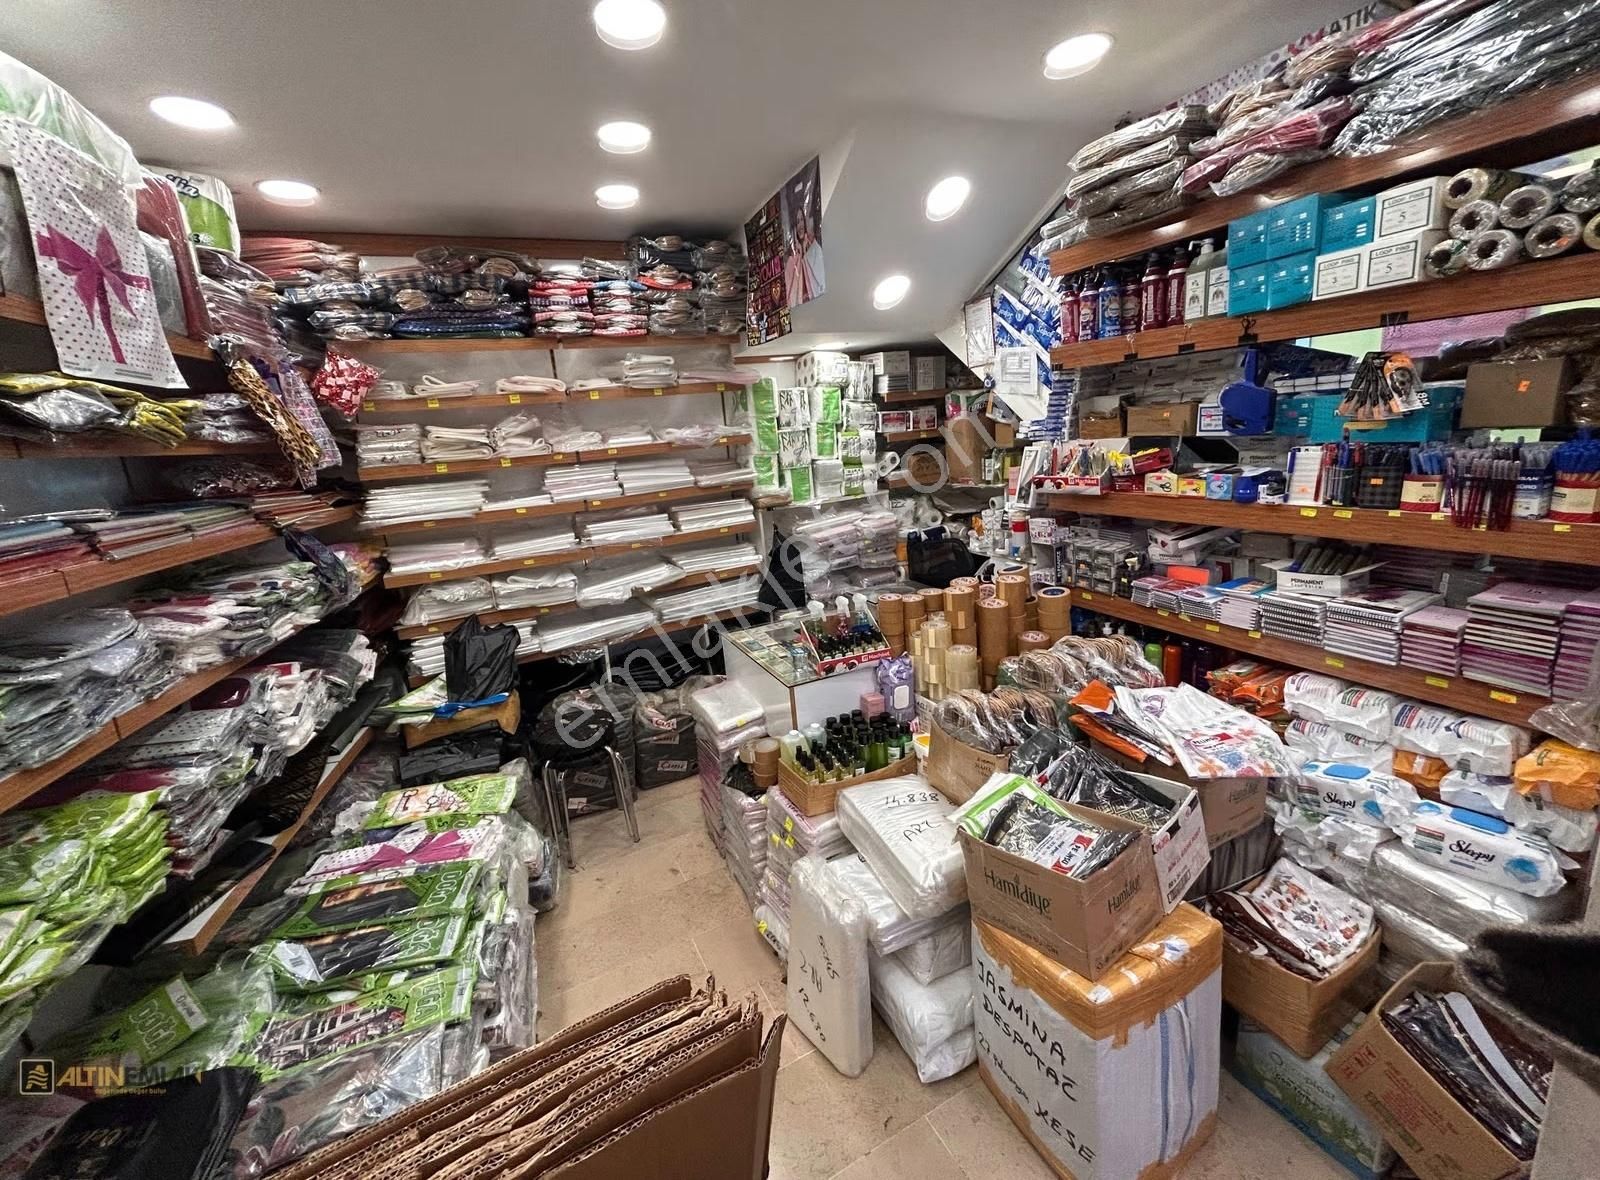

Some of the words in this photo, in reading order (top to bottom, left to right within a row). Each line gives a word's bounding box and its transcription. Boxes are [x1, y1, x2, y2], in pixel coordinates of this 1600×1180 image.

[1375, 247, 1394, 258] LOOP
[1384, 262, 1393, 274] 5
[1290, 577, 1324, 586] PERMANENT
[1322, 791, 1357, 809] Sleepy
[1448, 839, 1497, 863] Sleepy
[984, 866, 1052, 915] Hamidiye
[976, 958, 1067, 1067] JASMINA
